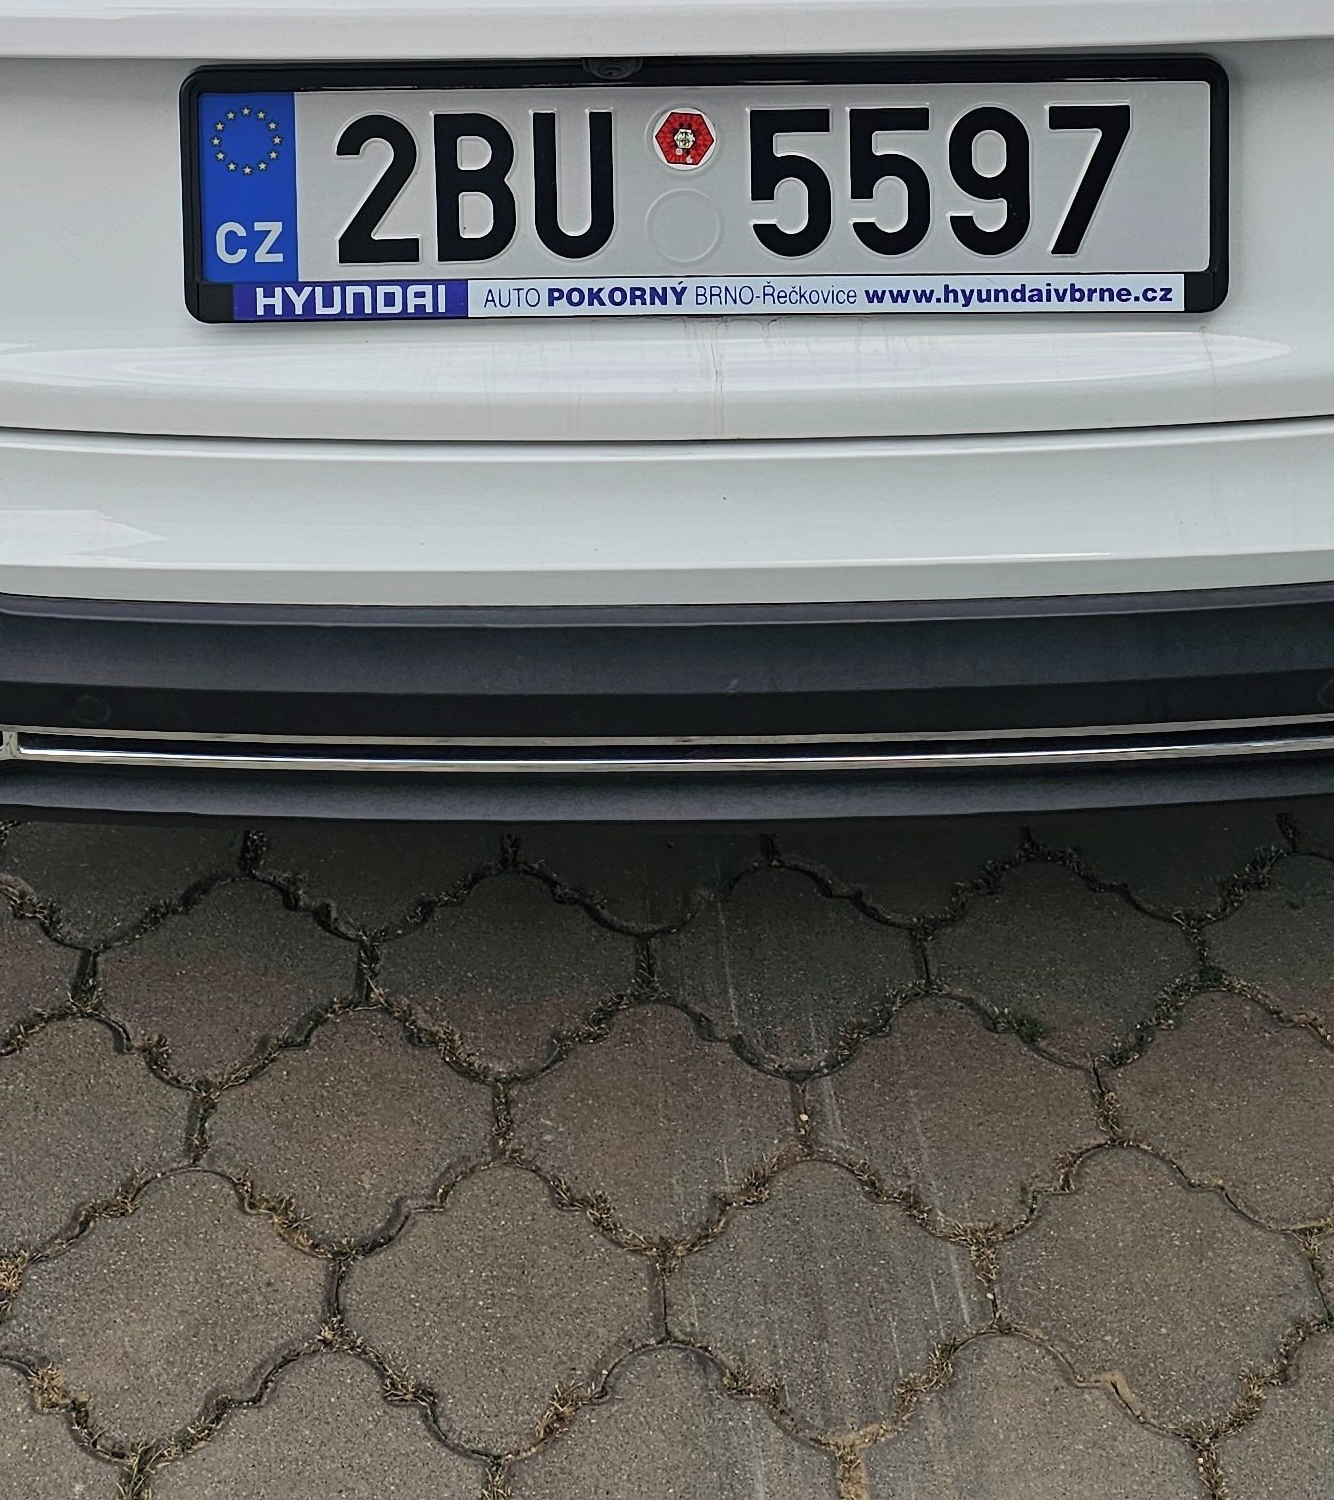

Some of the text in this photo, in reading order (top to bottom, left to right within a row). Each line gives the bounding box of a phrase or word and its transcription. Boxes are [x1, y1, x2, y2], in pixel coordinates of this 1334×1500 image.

[336, 104, 1131, 264] 2BU 5597
[215, 221, 284, 264] CZ
[256, 280, 1173, 316] HYUNDAI AUTO POKORNÝ BRNO-Řečkovice www.hyundaivbrne.cz
